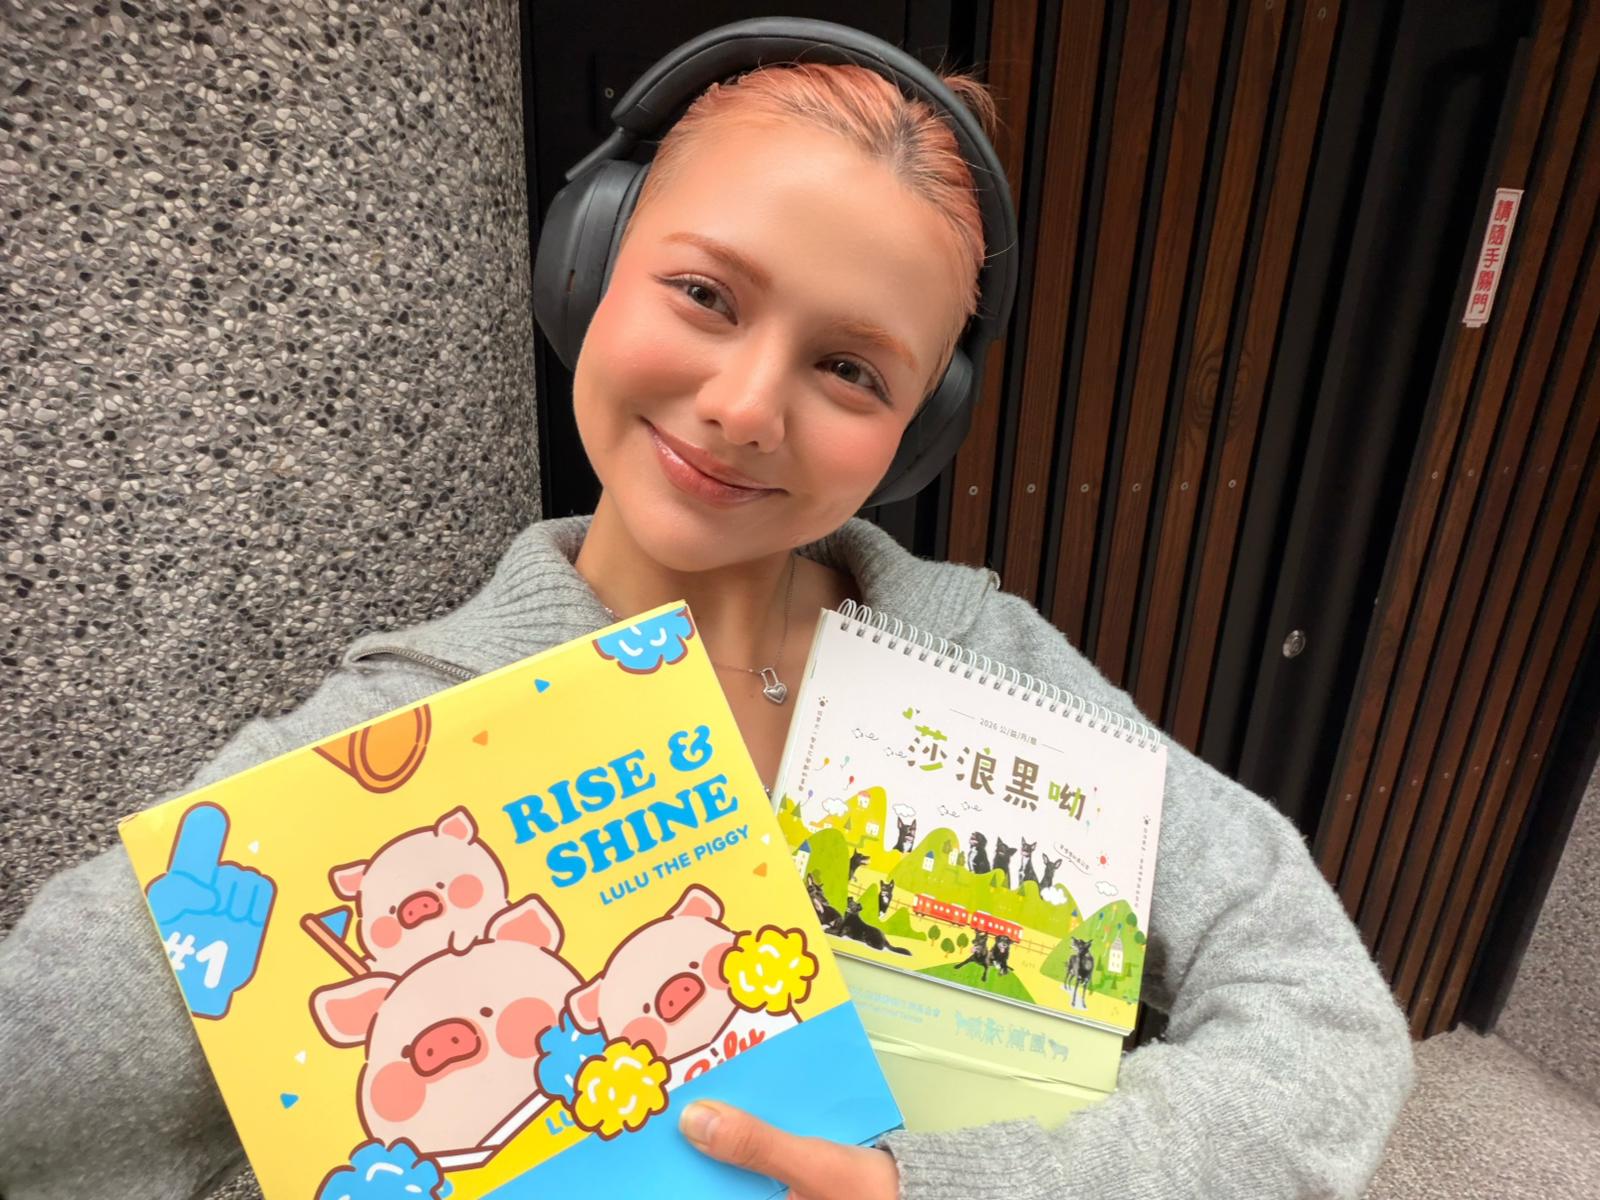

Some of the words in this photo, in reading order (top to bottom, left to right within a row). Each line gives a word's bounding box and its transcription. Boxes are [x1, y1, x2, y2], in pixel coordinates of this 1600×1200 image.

[1468, 199, 1514, 314] 請隨手關門
[980, 717, 998, 731] 2026
[502, 748, 656, 845] RISE
[667, 724, 714, 772] &
[545, 773, 739, 888] SHINE
[599, 871, 650, 906] LULU
[652, 852, 692, 879] THE
[693, 824, 749, 861] PIGGY
[163, 931, 229, 989] #1
